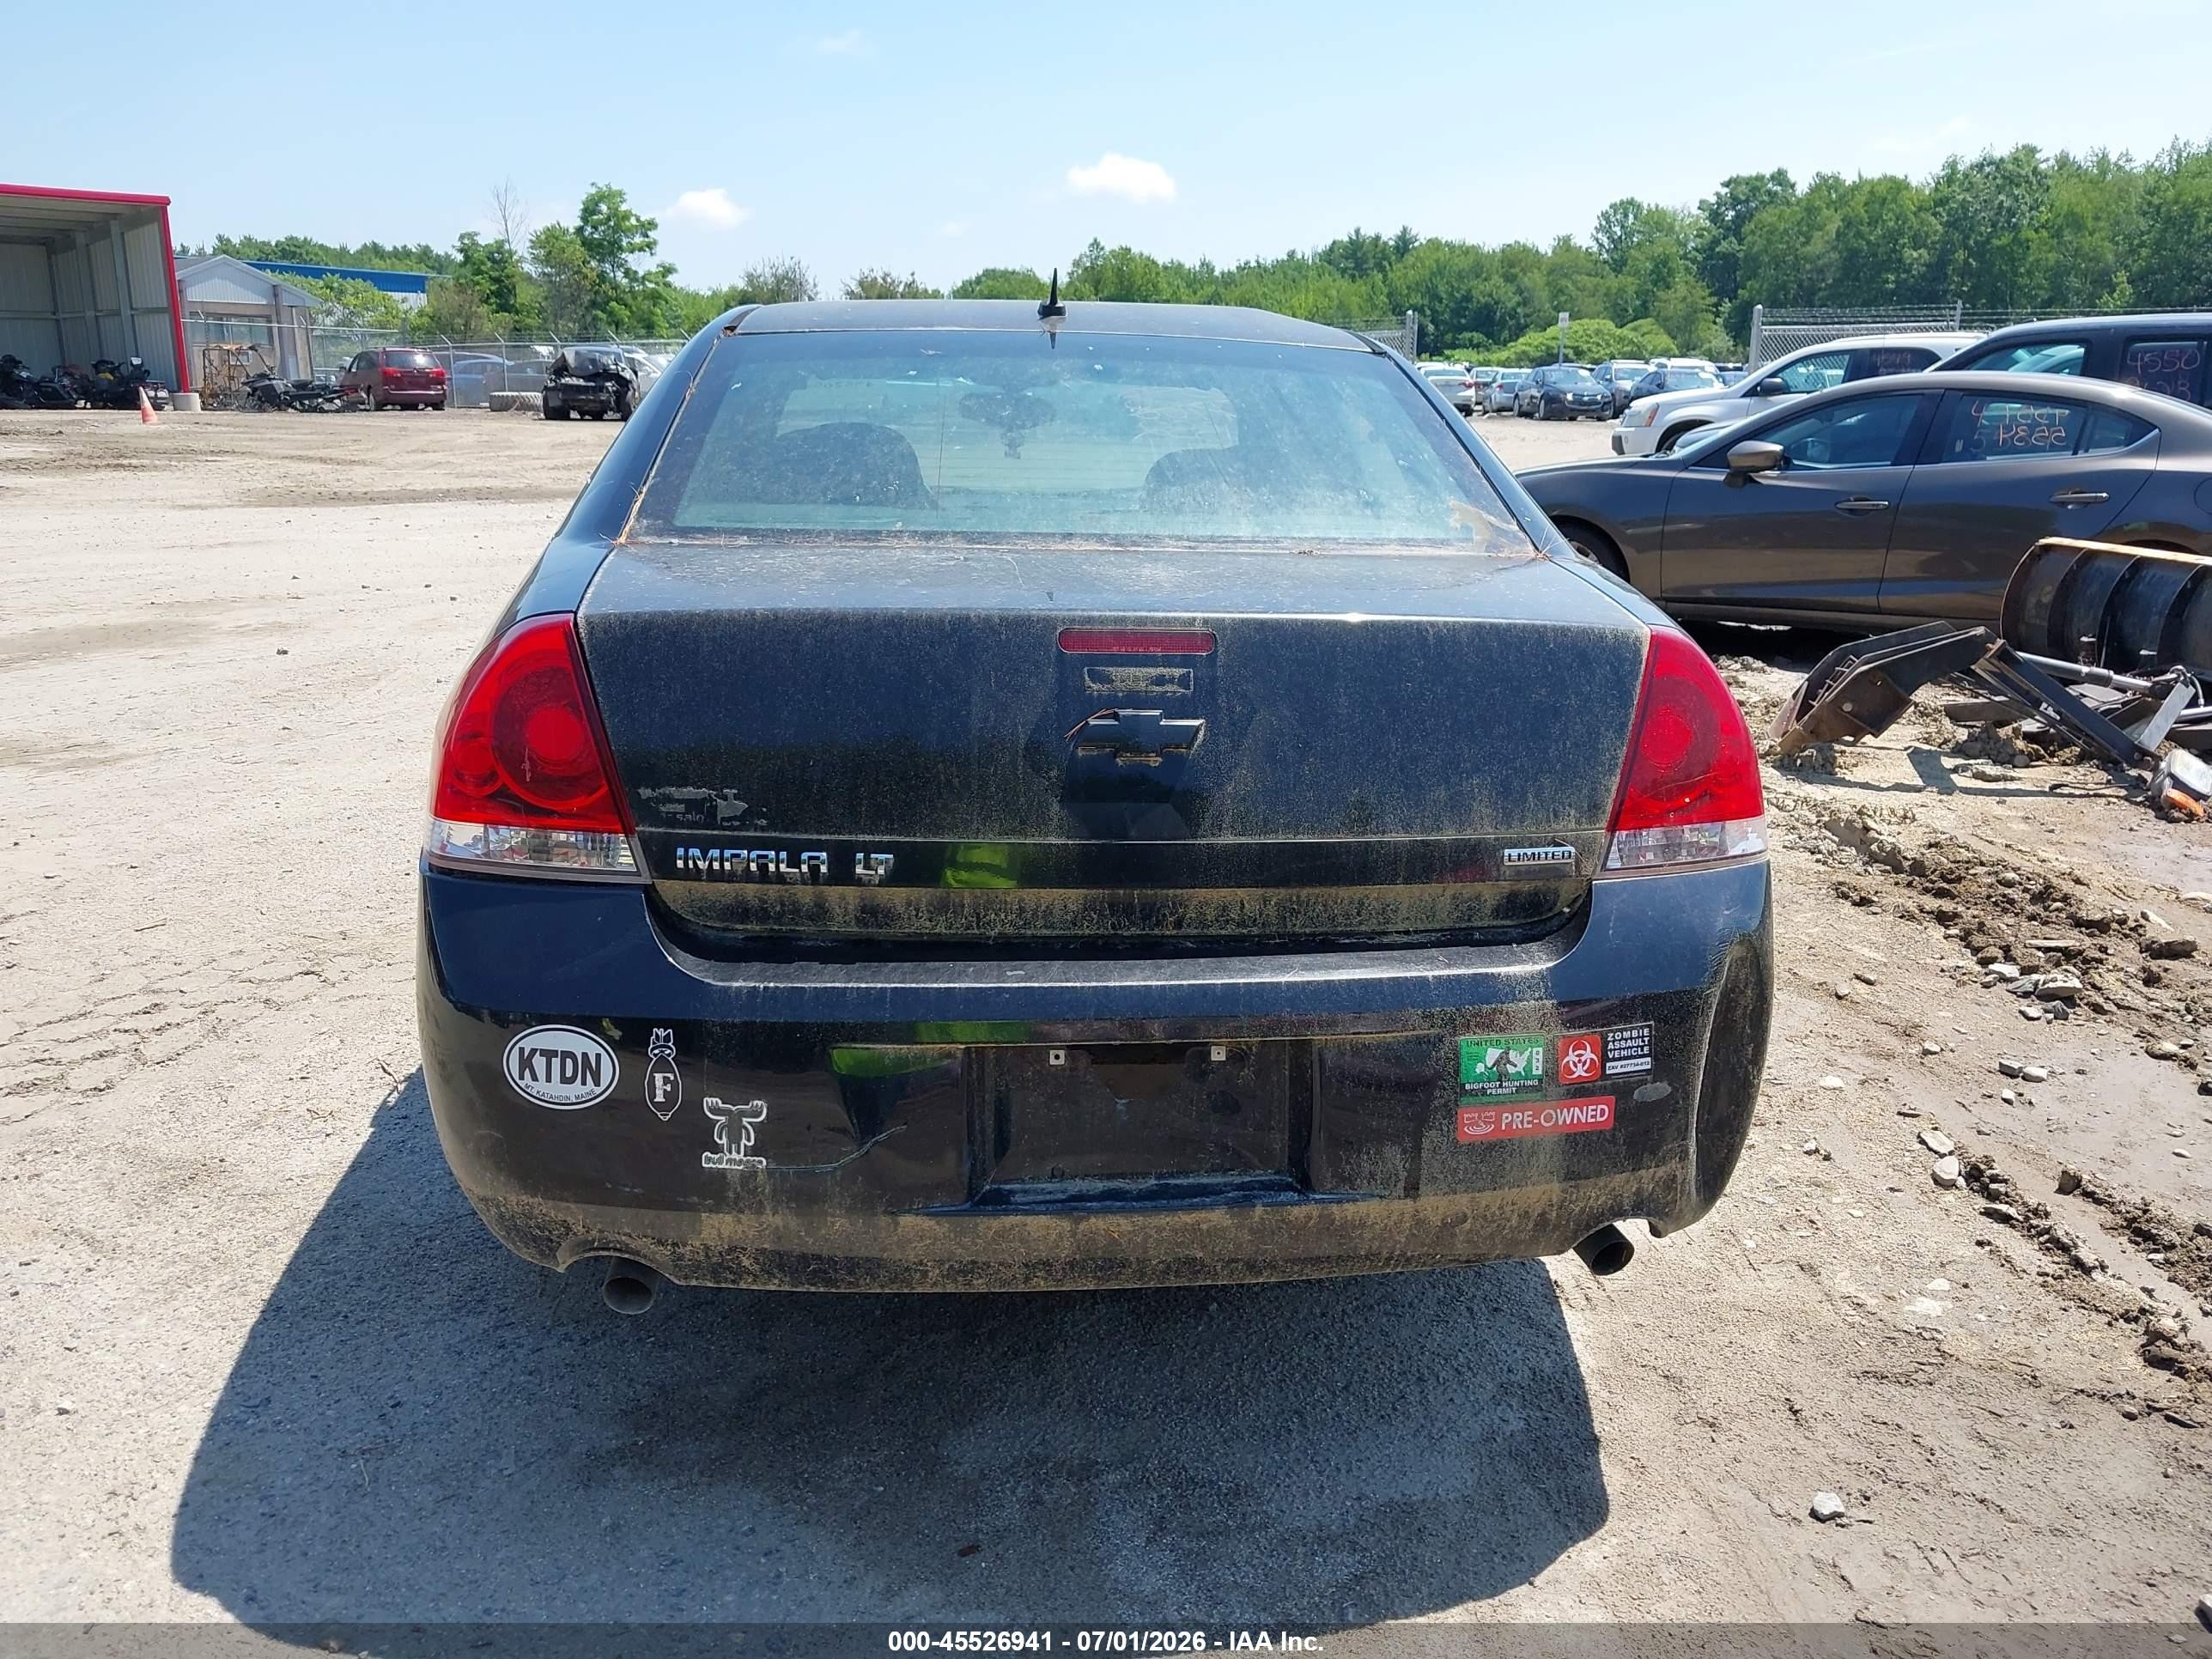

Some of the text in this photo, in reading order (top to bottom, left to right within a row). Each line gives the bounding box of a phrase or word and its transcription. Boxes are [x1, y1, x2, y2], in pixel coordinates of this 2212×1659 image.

[676, 848, 894, 875] IMPALA LT
[1508, 850, 1573, 862] LIMITED
[1607, 1028, 1650, 1041] ZOMBIE
[1467, 1036, 1539, 1048] UNITED STATES
[1607, 1036, 1650, 1049] ASSAULT
[1607, 1046, 1650, 1058] VEHICLE
[519, 1046, 602, 1087] KTDN
[653, 1073, 675, 1102] F
[1465, 1079, 1539, 1090] BIGFOOT HUNTING
[523, 1083, 597, 1102] MT. KATAHDIN, MAINE
[1501, 1104, 1609, 1130] PRE-OWNED
